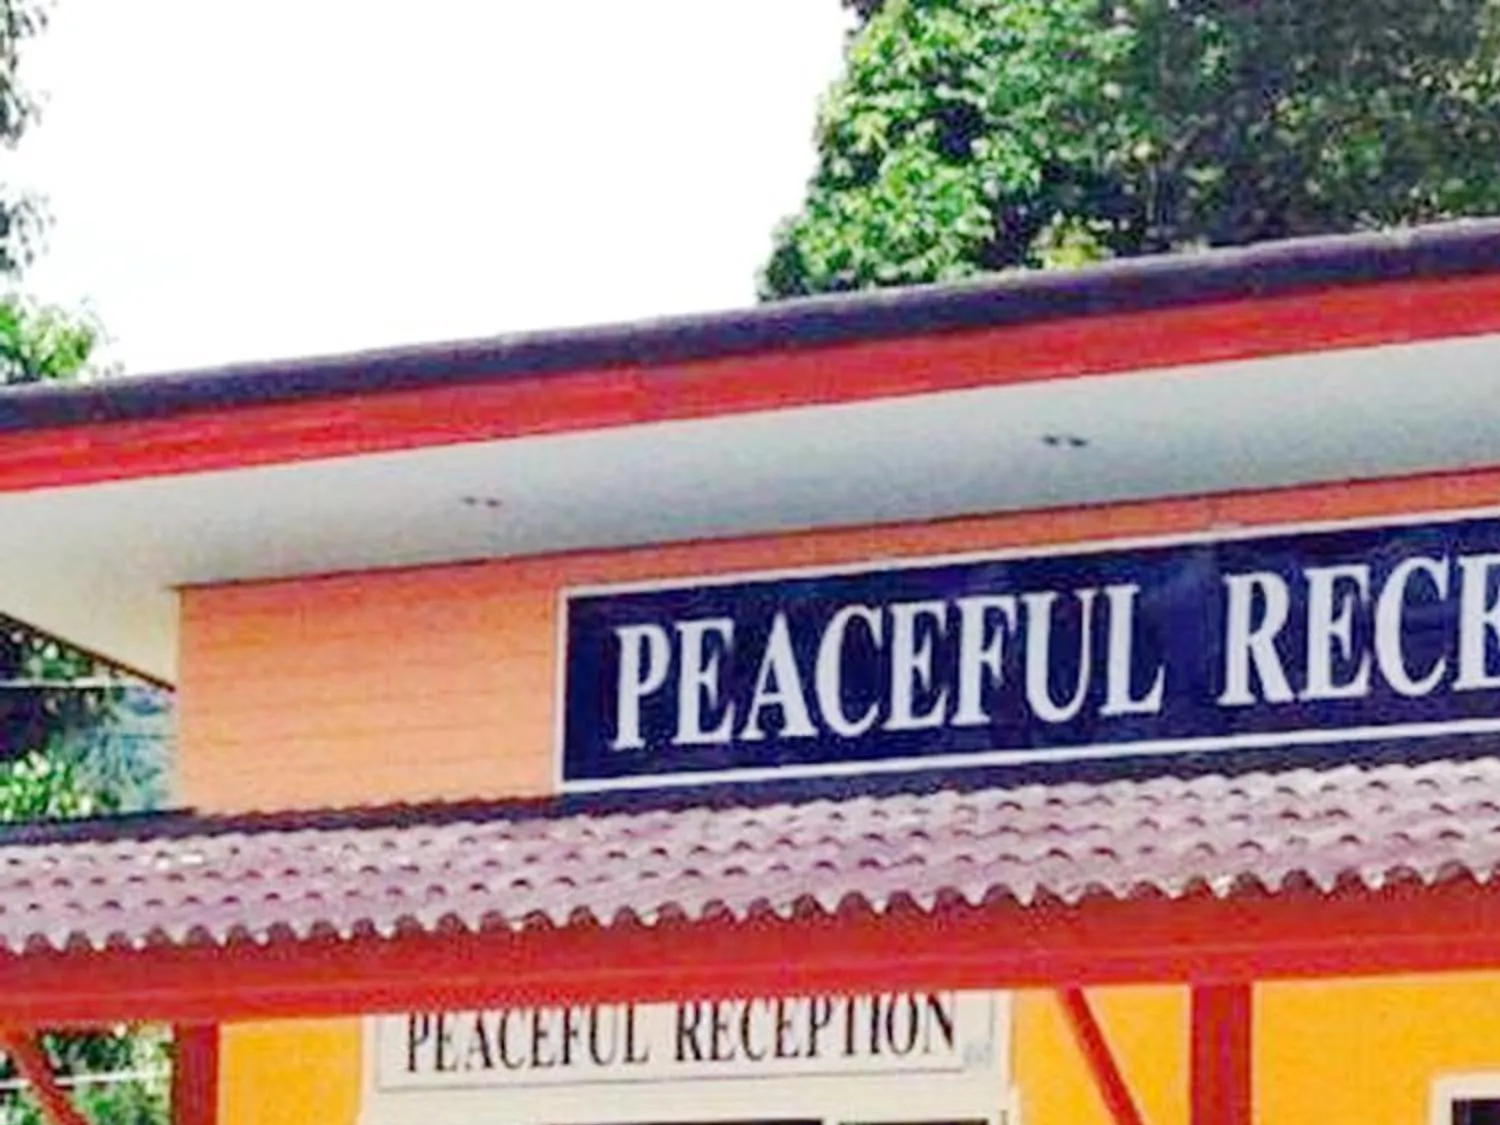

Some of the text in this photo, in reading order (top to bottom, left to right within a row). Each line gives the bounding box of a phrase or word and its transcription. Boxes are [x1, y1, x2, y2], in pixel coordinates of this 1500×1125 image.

[612, 583, 1165, 751] PEACEFUL
[406, 992, 955, 1072] PEACEFUL RECEPTION
